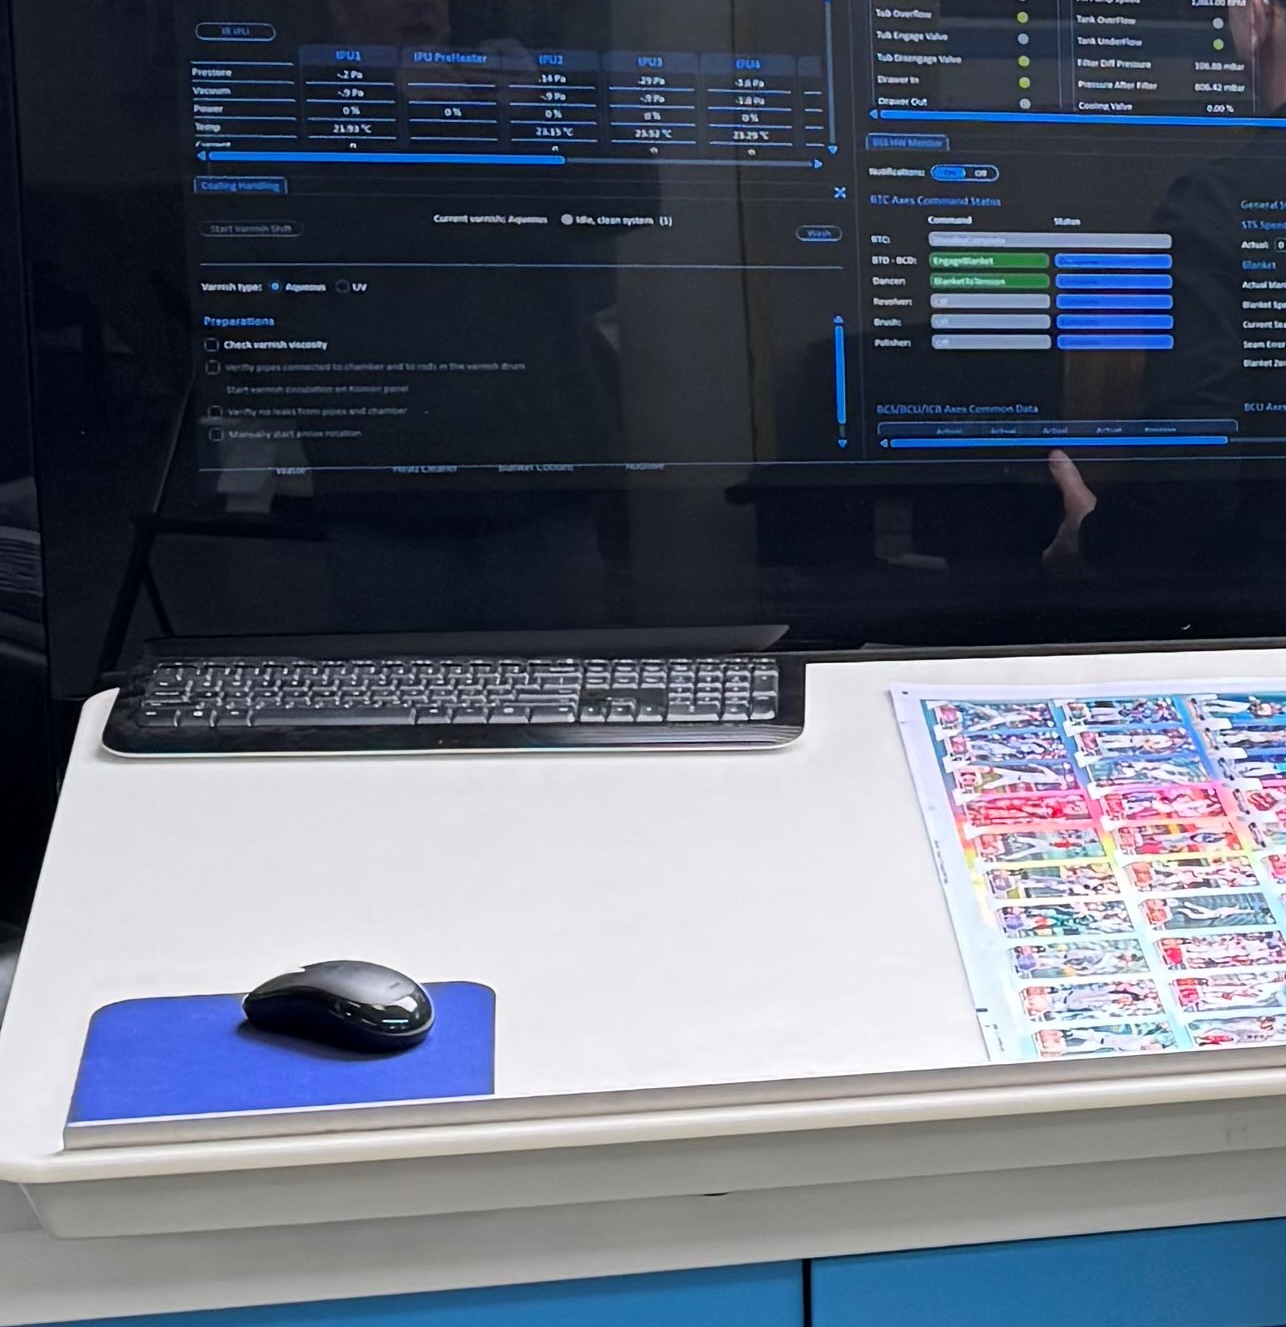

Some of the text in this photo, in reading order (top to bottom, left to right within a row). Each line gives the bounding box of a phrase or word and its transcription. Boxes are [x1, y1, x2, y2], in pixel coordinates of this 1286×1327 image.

[876, 9, 891, 18] Tub
[1117, 60, 1151, 69] Pressure
[1115, 81, 1135, 90] After
[1136, 81, 1157, 90] Filter
[891, 195, 915, 205] Axes
[917, 196, 968, 206] Command
[970, 197, 1001, 207] Status
[1241, 200, 1278, 210] General
[927, 216, 973, 225] Command
[1242, 260, 1276, 270] Blanket
[352, 283, 368, 291] UV
[204, 317, 274, 328] Preparations
[224, 340, 252, 350] Check
[944, 405, 967, 414] Axes
[969, 405, 1014, 414] Common
[1016, 405, 1038, 414] Data
